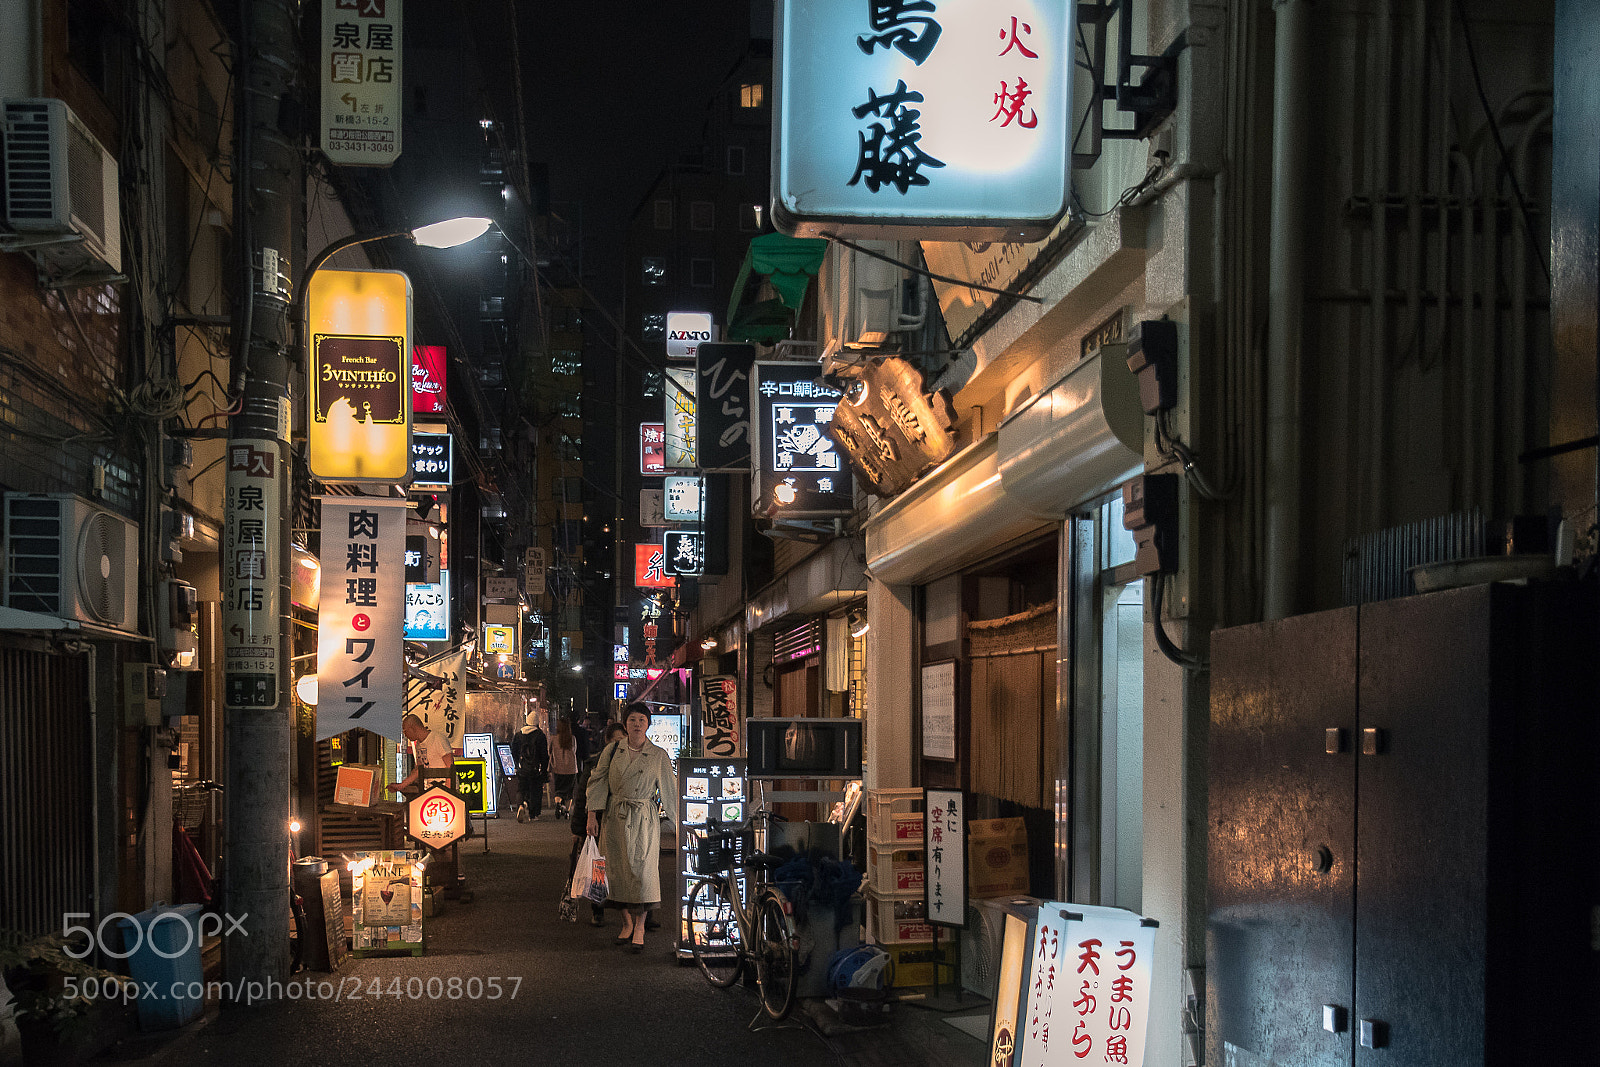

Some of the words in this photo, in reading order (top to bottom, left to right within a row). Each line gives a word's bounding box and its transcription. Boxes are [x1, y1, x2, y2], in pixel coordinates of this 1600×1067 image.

[332, 22, 393, 50] 泉屋
[331, 53, 393, 83] 質店
[360, 104, 384, 113] 左折
[329, 141, 394, 152] 03-3431-3049
[322, 364, 397, 383] 3VINTHÉO
[342, 356, 363, 364] French
[233, 449, 270, 474] 買入
[228, 486, 236, 612] 03-3431-3049
[236, 484, 265, 612] 泉屋質店
[343, 508, 379, 719] 肉料理とワイン
[946, 799, 957, 832] 奥に
[931, 806, 943, 913] 空席有ります
[1071, 938, 1103, 1058] 天ぷら
[1106, 940, 1137, 1065] うまい魚
